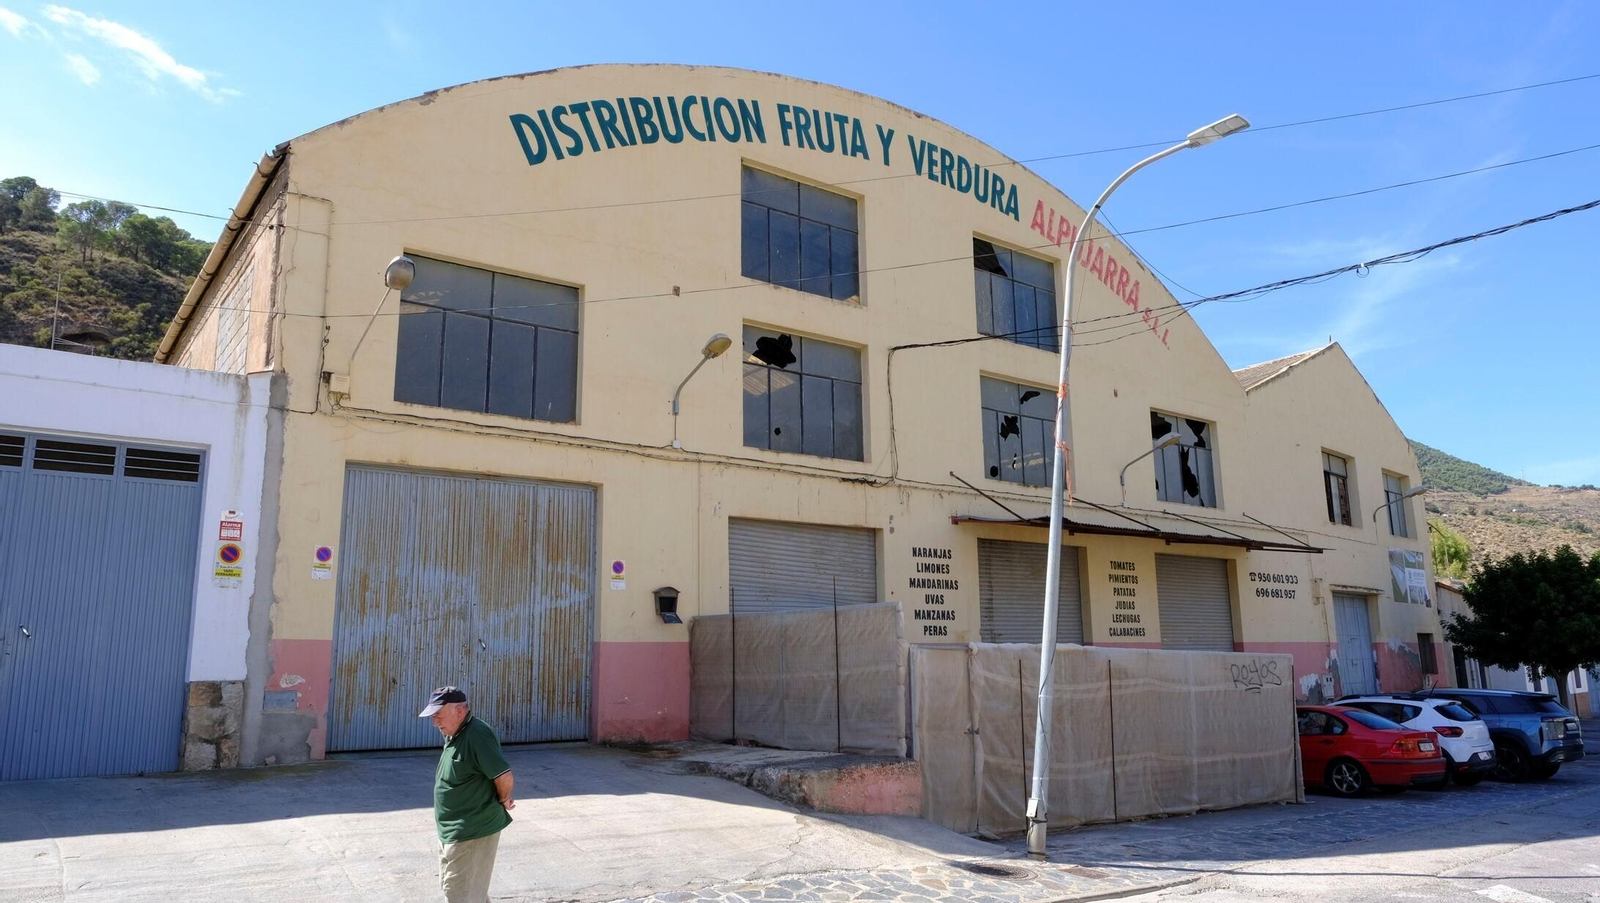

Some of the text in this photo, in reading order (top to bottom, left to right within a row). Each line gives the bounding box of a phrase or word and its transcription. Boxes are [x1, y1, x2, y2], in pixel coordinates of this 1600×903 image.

[508, 95, 767, 166] DISTRIBUCION
[776, 103, 870, 161] FRUTA
[875, 123, 895, 167] Y
[907, 134, 1020, 222] VERDURA
[912, 547, 952, 559] NARANJAS
[916, 562, 950, 574] LIMONES
[1110, 561, 1136, 571] TOMATES
[909, 577, 959, 590] MANDARINAS
[1108, 574, 1139, 584] PIMIENTOS
[1257, 572, 1299, 584] 950 601933
[1113, 587, 1136, 597] PATATAS
[1255, 587, 1296, 599] 696 681957
[925, 594, 945, 605] UVAS
[1115, 601, 1136, 610] JUDIAS
[914, 609, 956, 621] MANZANAS
[1112, 613, 1141, 623] LECHUGAS
[923, 625, 948, 636] PERAS
[1108, 627, 1146, 637] CALABACINES
